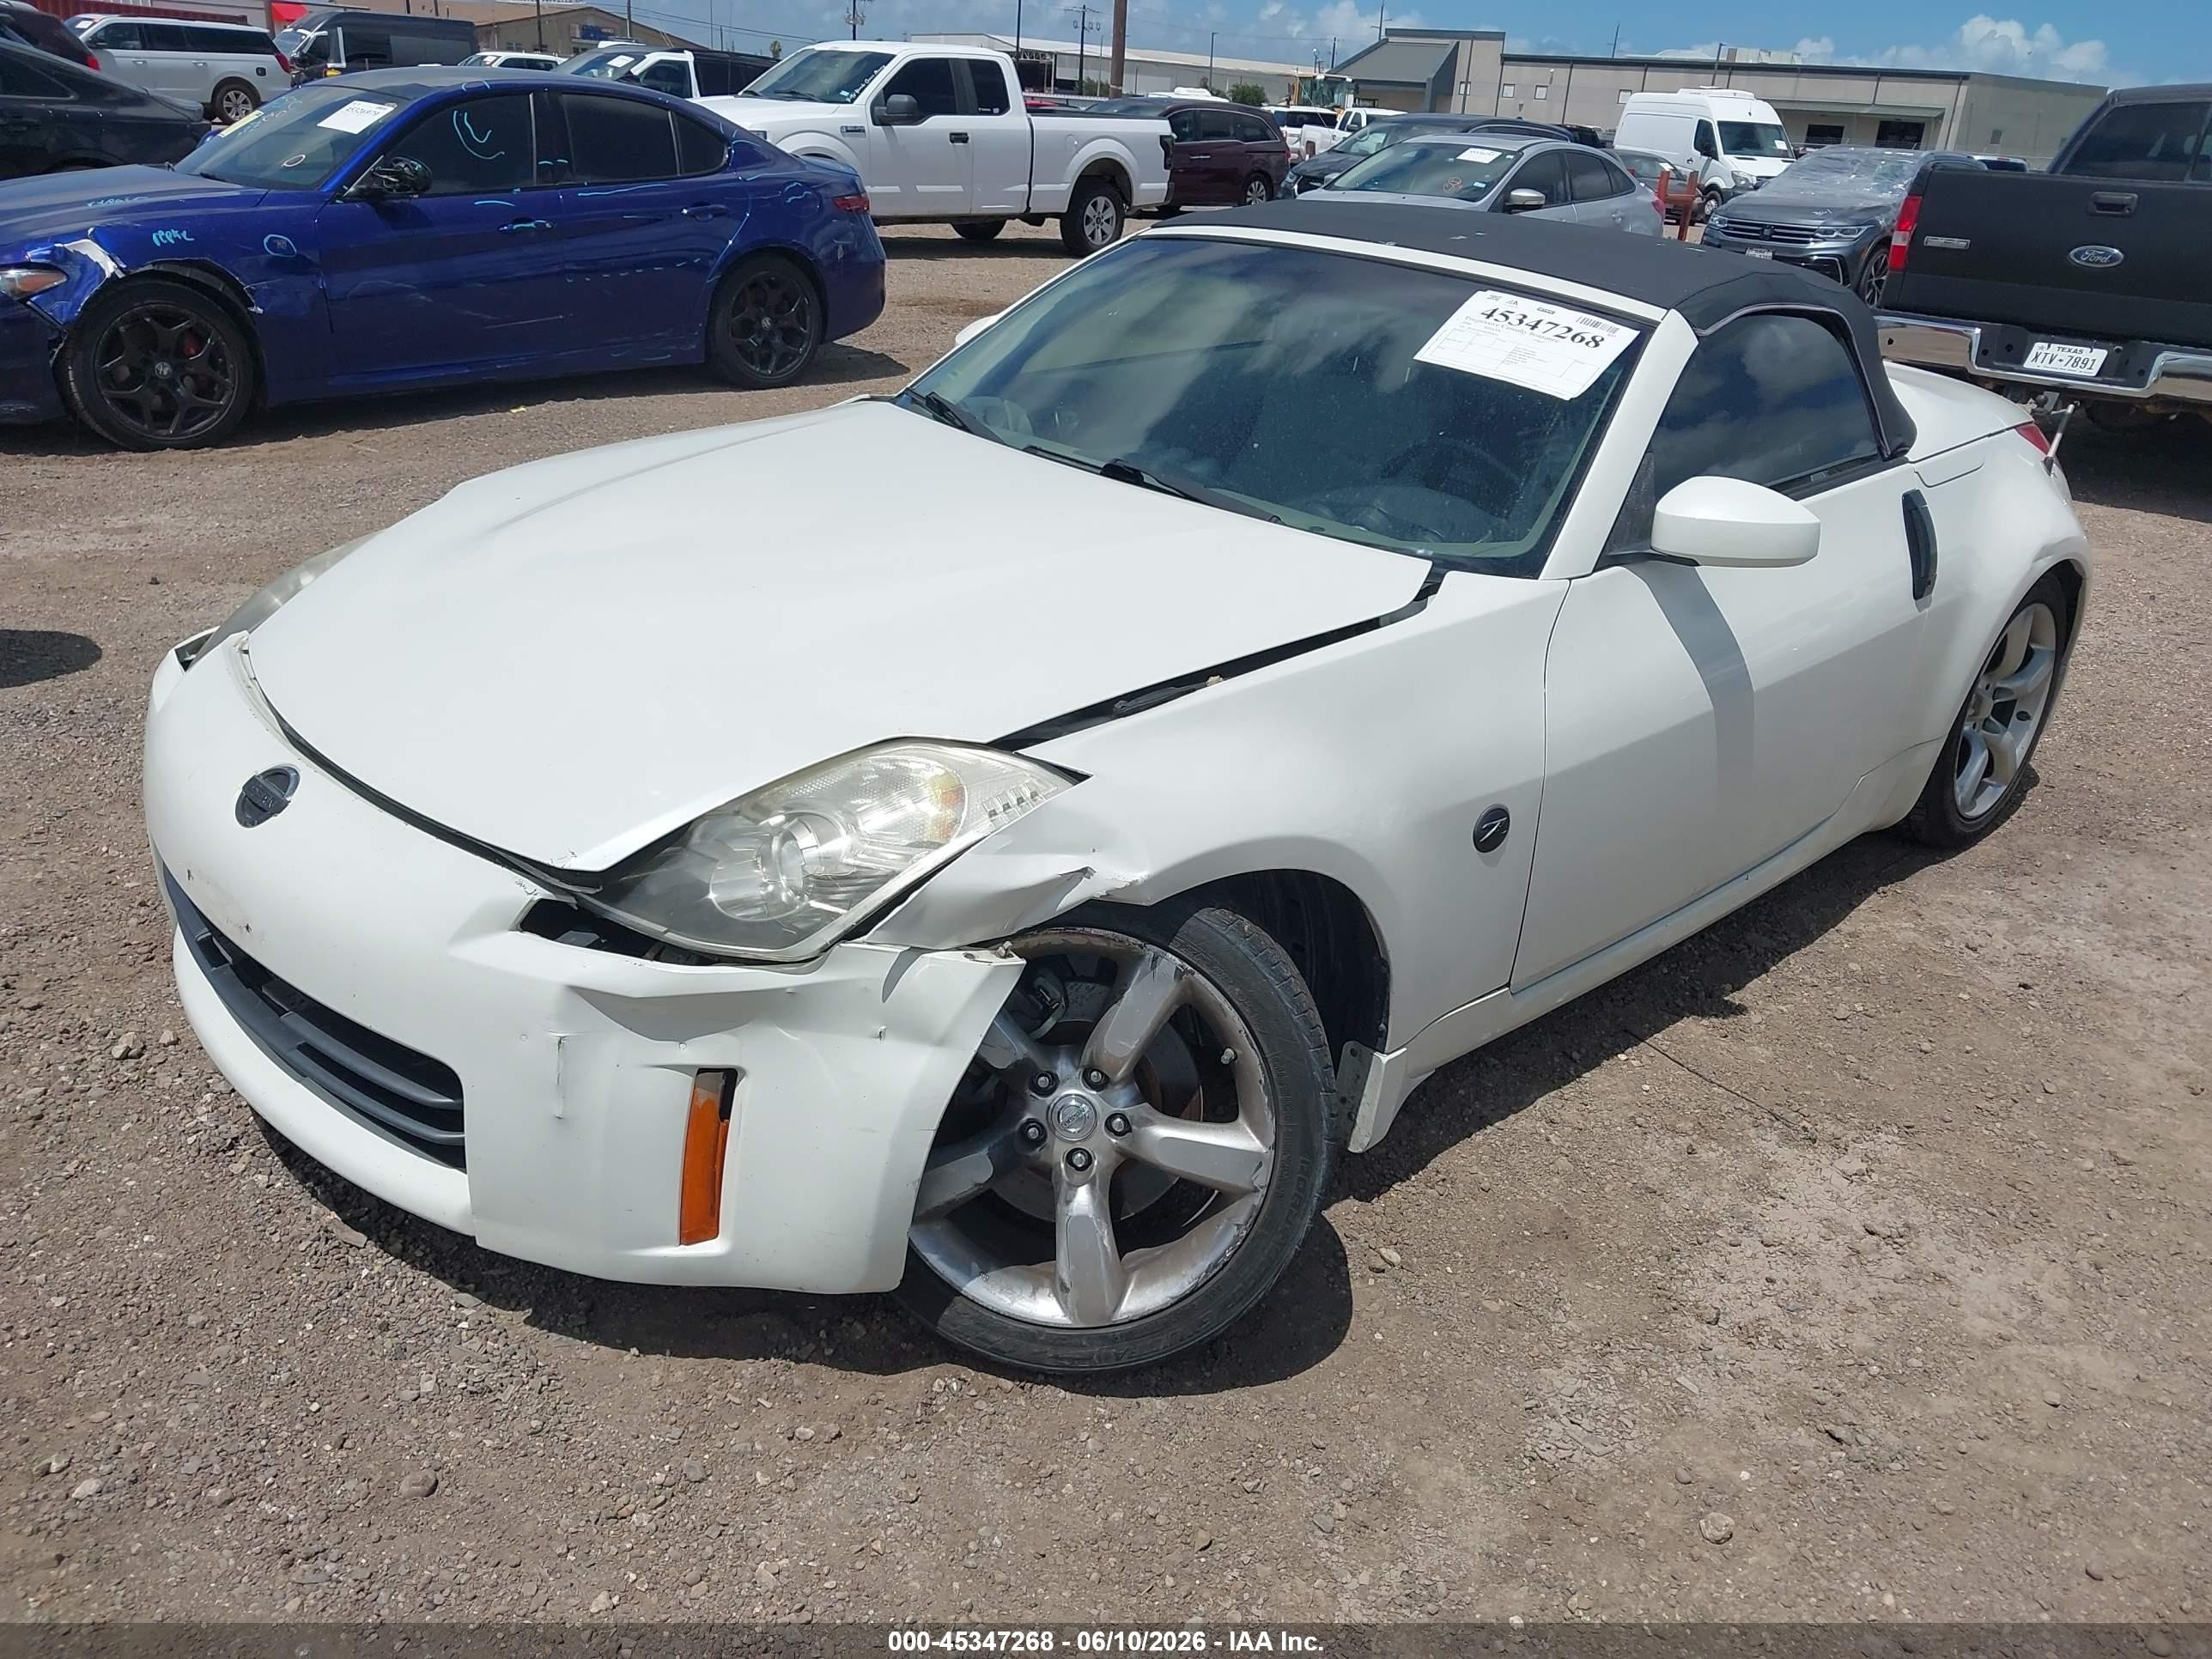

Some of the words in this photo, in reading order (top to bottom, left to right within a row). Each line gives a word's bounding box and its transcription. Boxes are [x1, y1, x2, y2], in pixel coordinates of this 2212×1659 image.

[2081, 249, 2111, 263] Ford
[1480, 307, 1605, 349] 45347268
[2057, 346, 2084, 355] TEXAS
[1061, 1107, 1086, 1128] NISSAN
